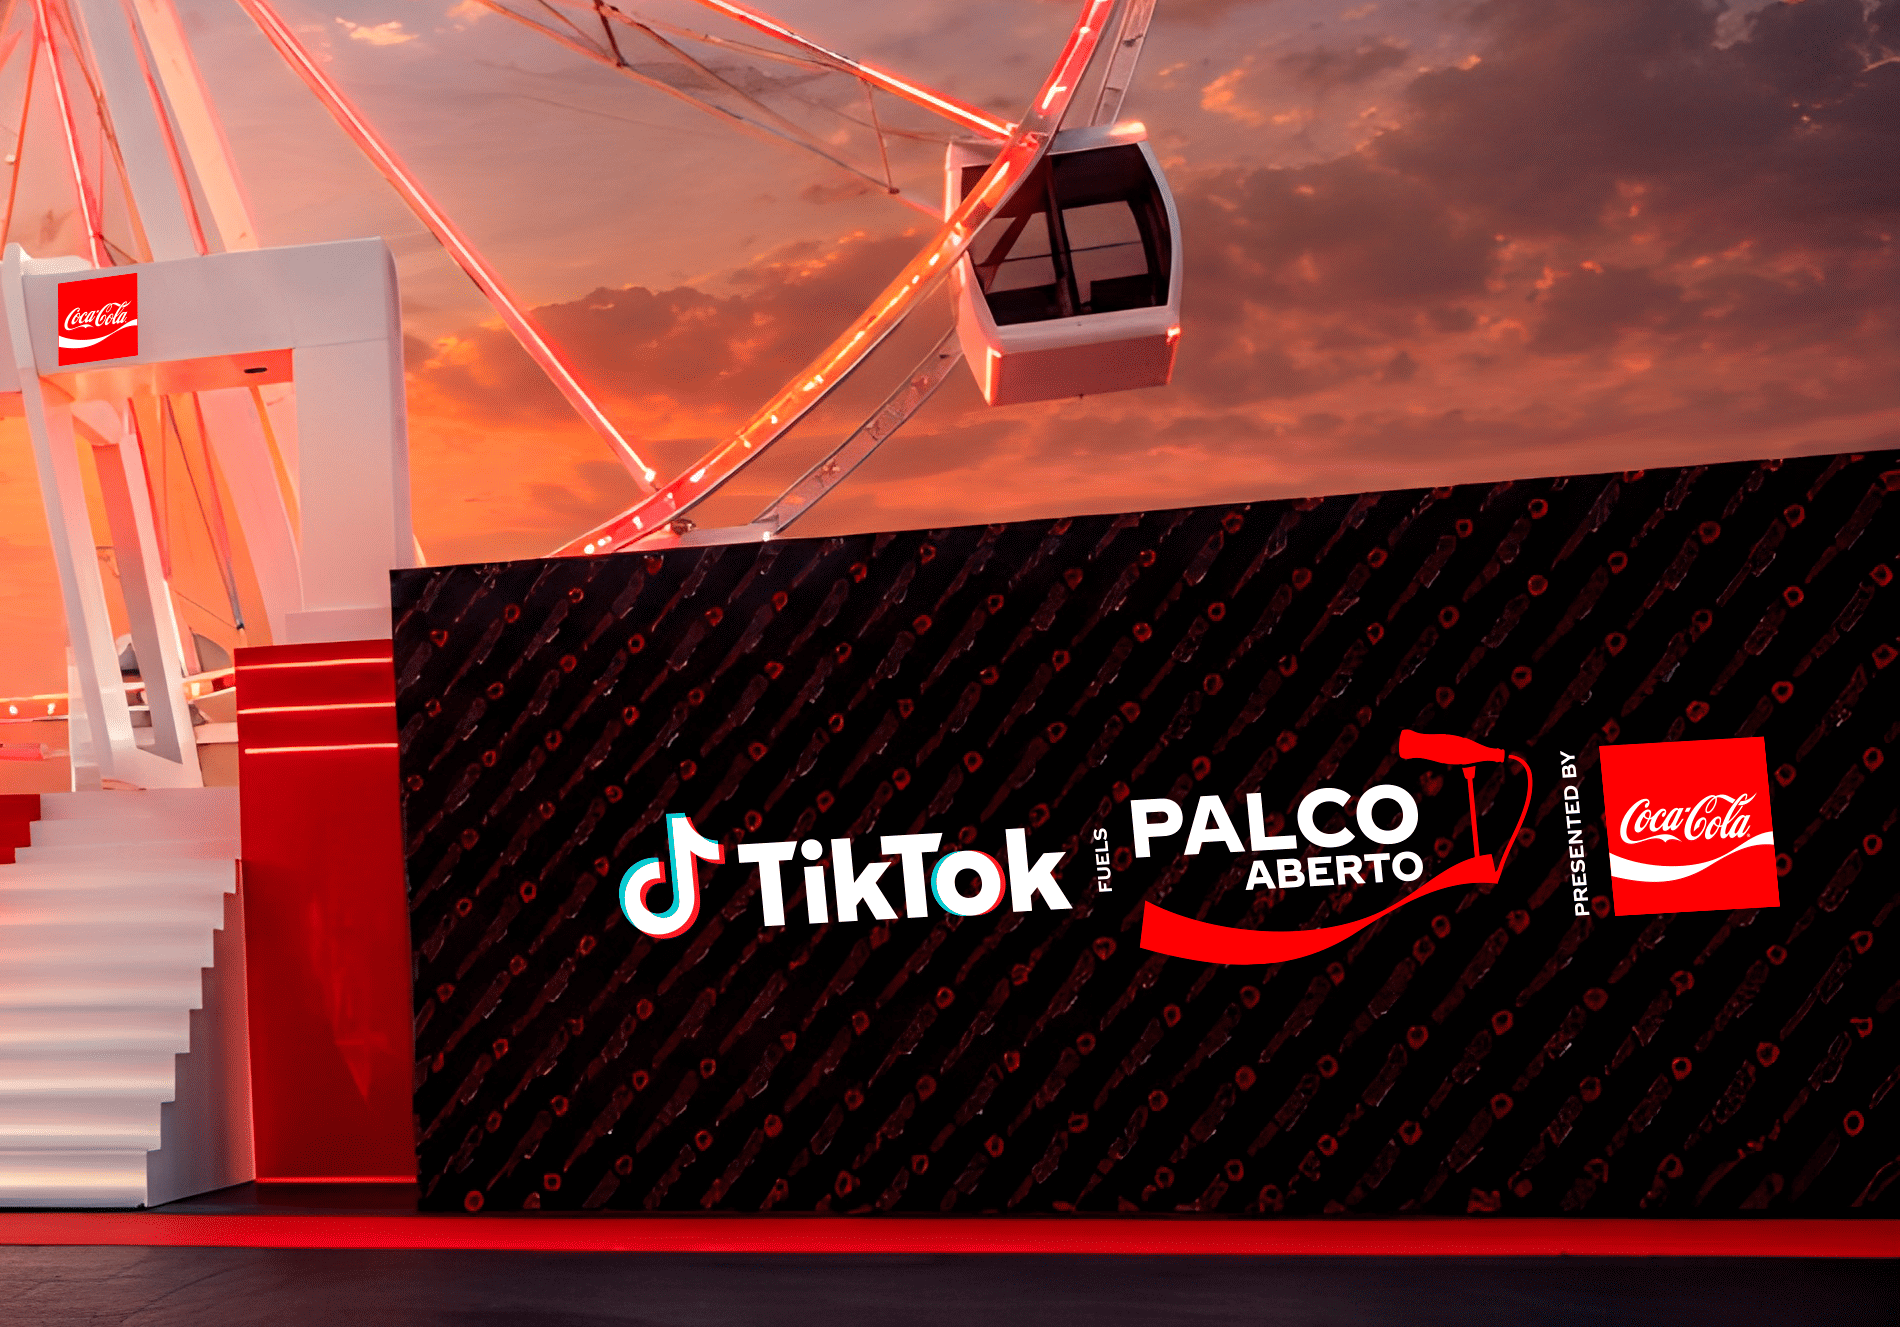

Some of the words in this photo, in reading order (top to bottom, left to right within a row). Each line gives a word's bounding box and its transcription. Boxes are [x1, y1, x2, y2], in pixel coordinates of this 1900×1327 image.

[63, 300, 132, 331] Coca-Cola
[1559, 750, 1578, 779] BY
[1130, 784, 1419, 859] PALCO
[1619, 793, 1757, 845] Coca-Cola
[737, 827, 1073, 927] TikTok
[1093, 827, 1113, 893] FUELS
[1245, 850, 1424, 891] ABERTO
[1563, 785, 1590, 917] PRESENTED
